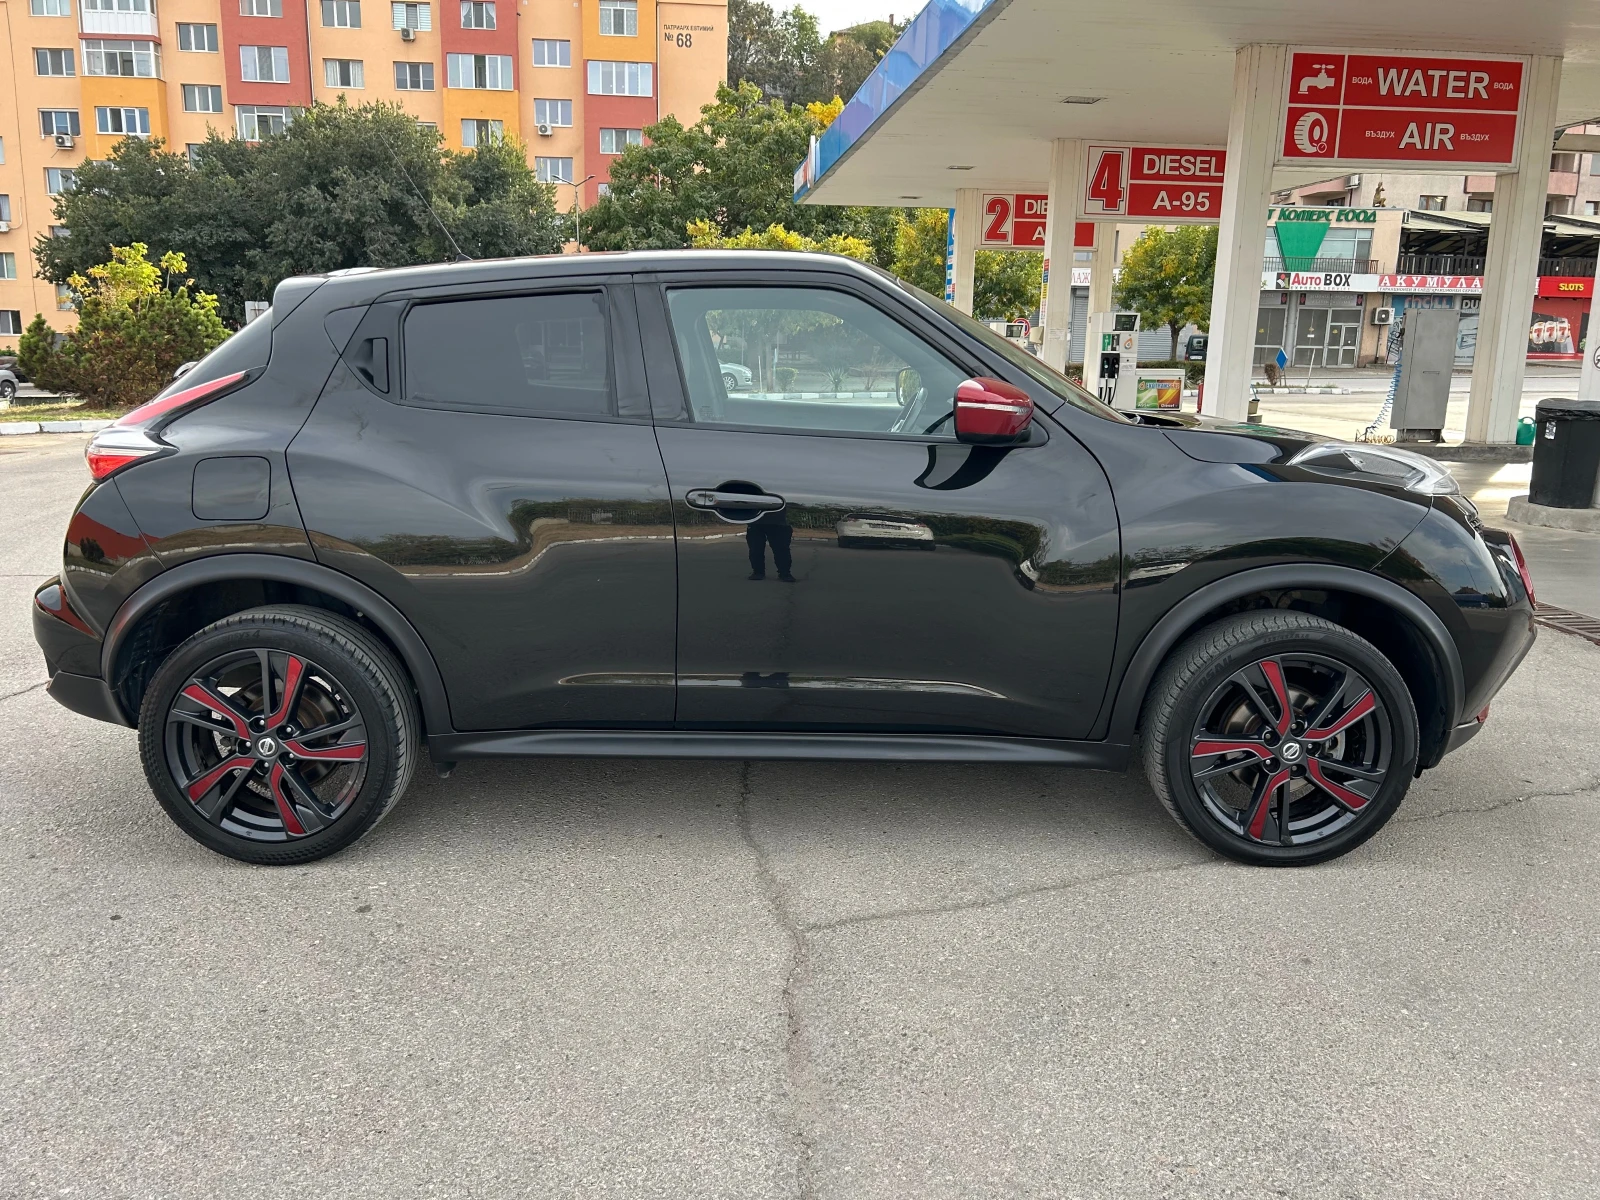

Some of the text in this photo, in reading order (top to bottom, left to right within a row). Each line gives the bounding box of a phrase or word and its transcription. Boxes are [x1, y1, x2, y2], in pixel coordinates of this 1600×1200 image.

[676, 32, 692, 48] 68
[1352, 67, 1514, 99] ВОДА WATER ВОДА
[1365, 122, 1490, 151] ВЪЗДУХ AIR ВЪЗДУХ
[1142, 154, 1224, 177] DIESEL
[1087, 150, 1125, 211] 4
[1024, 199, 1048, 215] DIE
[1152, 190, 1210, 212] A-95
[985, 196, 1012, 241] 2
[1335, 209, 1377, 223] ЕООД
[1323, 273, 1352, 287] BOX
[1380, 275, 1482, 288] АКУМУЛА
[1559, 283, 1585, 291] SLOTS
